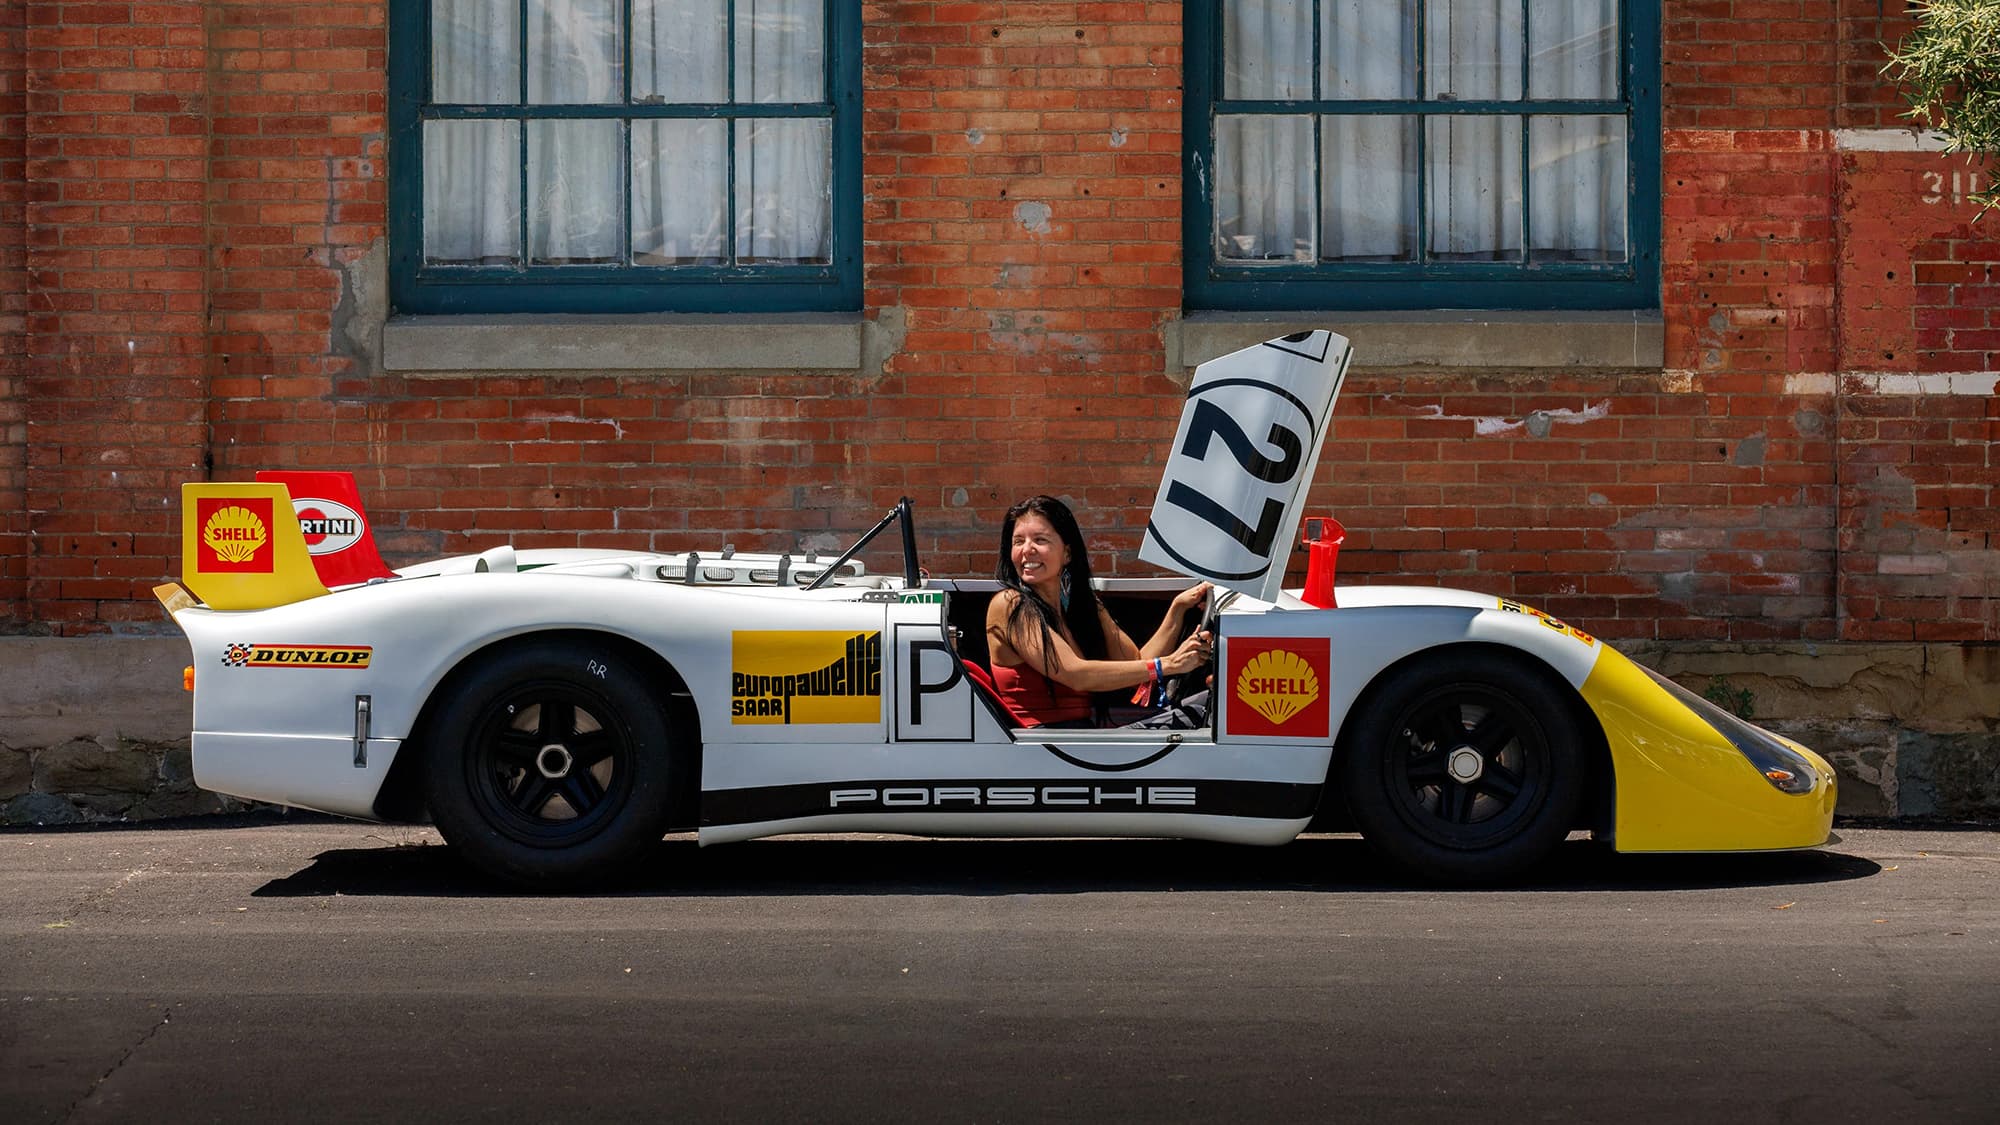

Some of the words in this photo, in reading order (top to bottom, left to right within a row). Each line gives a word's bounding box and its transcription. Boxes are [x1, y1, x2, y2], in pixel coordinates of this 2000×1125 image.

[1166, 398, 1302, 558] 27
[213, 527, 259, 541] SHELL
[300, 519, 353, 534] RTINI
[253, 649, 370, 664] DUNLOP
[586, 659, 608, 680] RR
[910, 640, 964, 726] P
[1248, 677, 1310, 695] SHELL
[732, 699, 783, 717] SAAR
[829, 786, 1197, 808] PORSCHE
